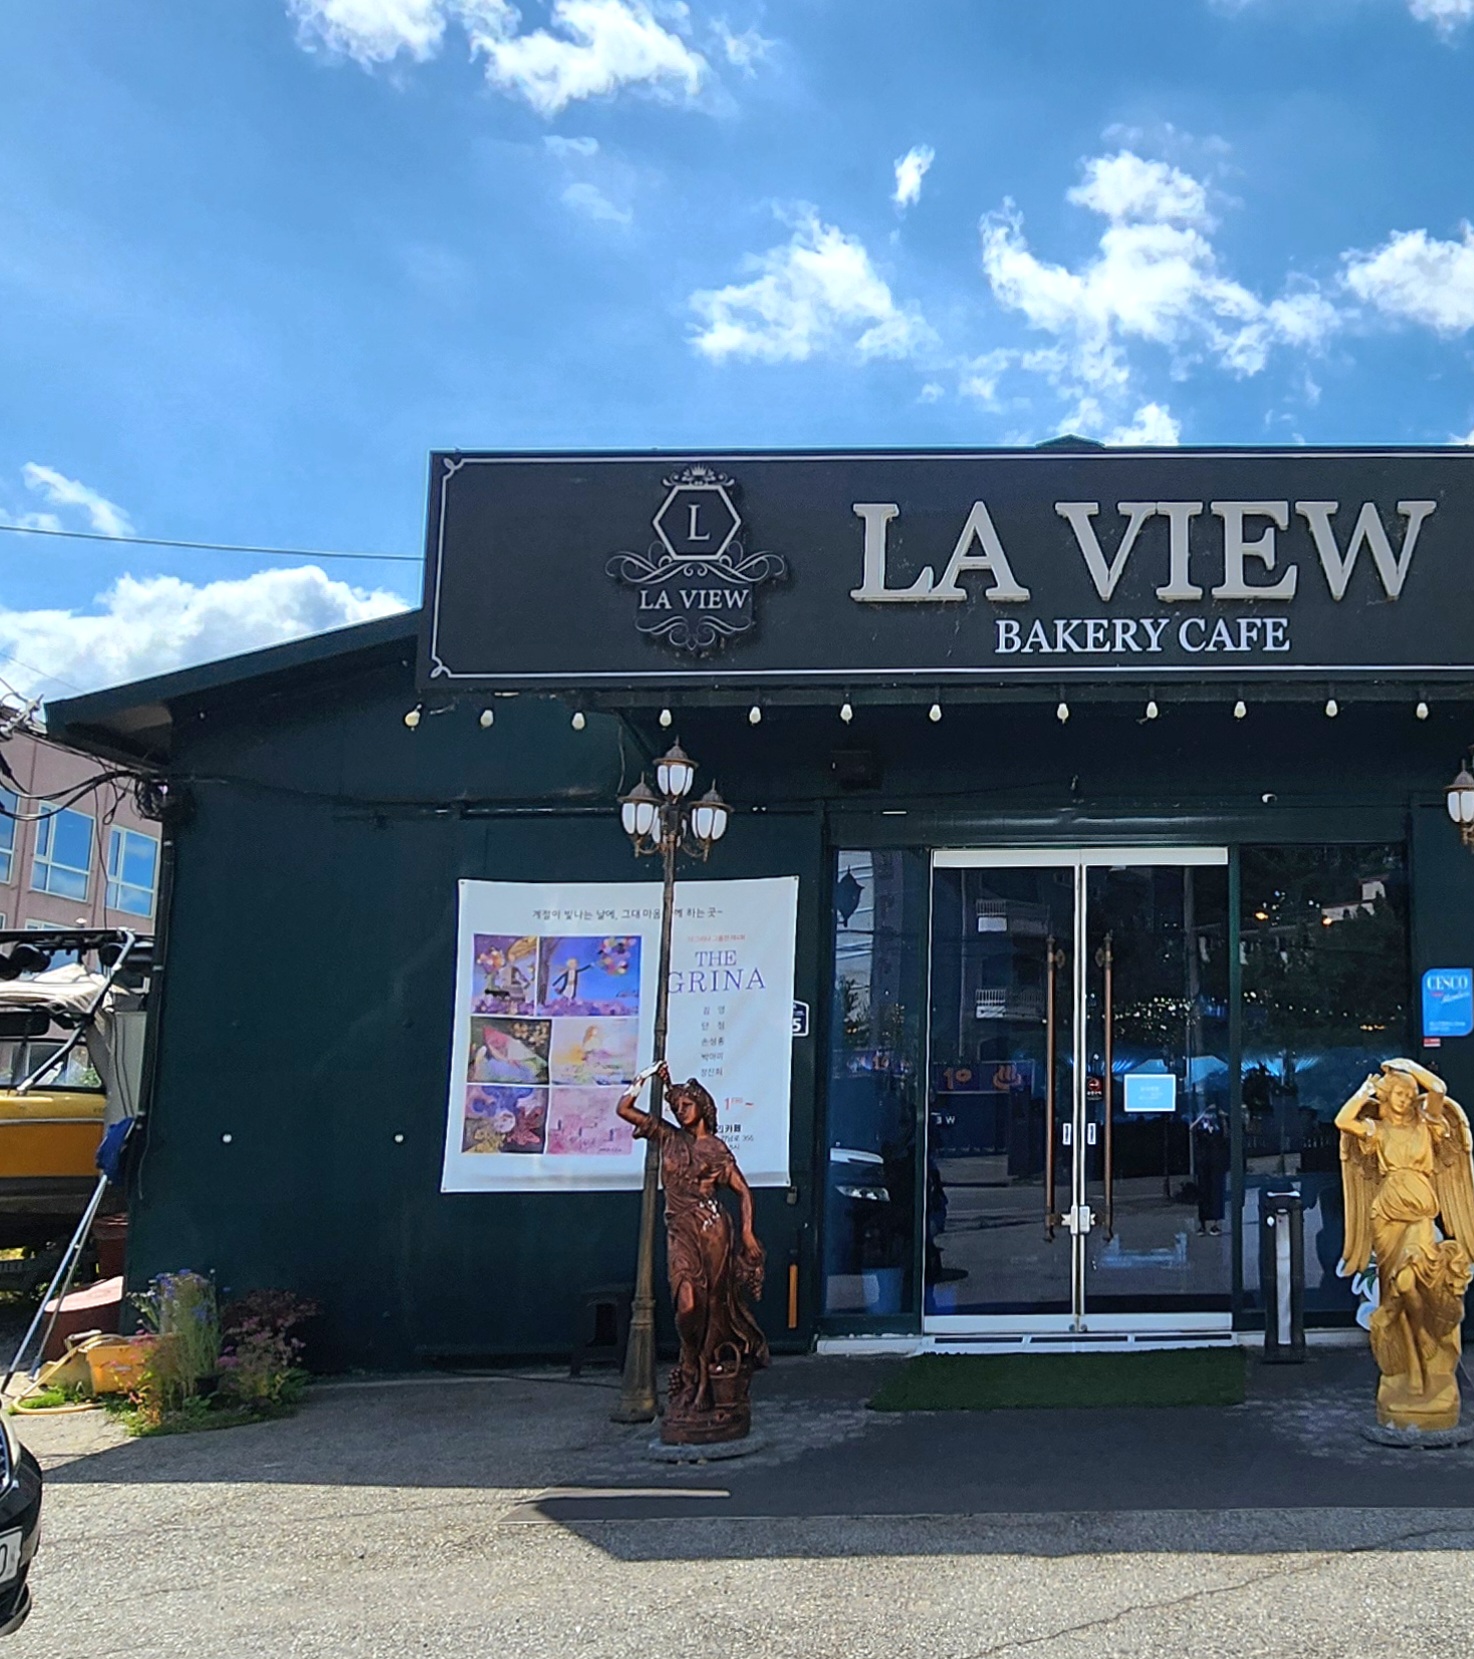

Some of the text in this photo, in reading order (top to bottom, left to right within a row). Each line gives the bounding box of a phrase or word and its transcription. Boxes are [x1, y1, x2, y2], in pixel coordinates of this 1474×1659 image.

[686, 503, 711, 541] L
[850, 500, 1437, 602] LA VIEW
[639, 589, 750, 610] LA VIEW
[994, 615, 1291, 654] BAKERY CAFE
[695, 950, 737, 967] THE
[668, 967, 766, 995] GRINA
[1426, 975, 1469, 991] CESCO
